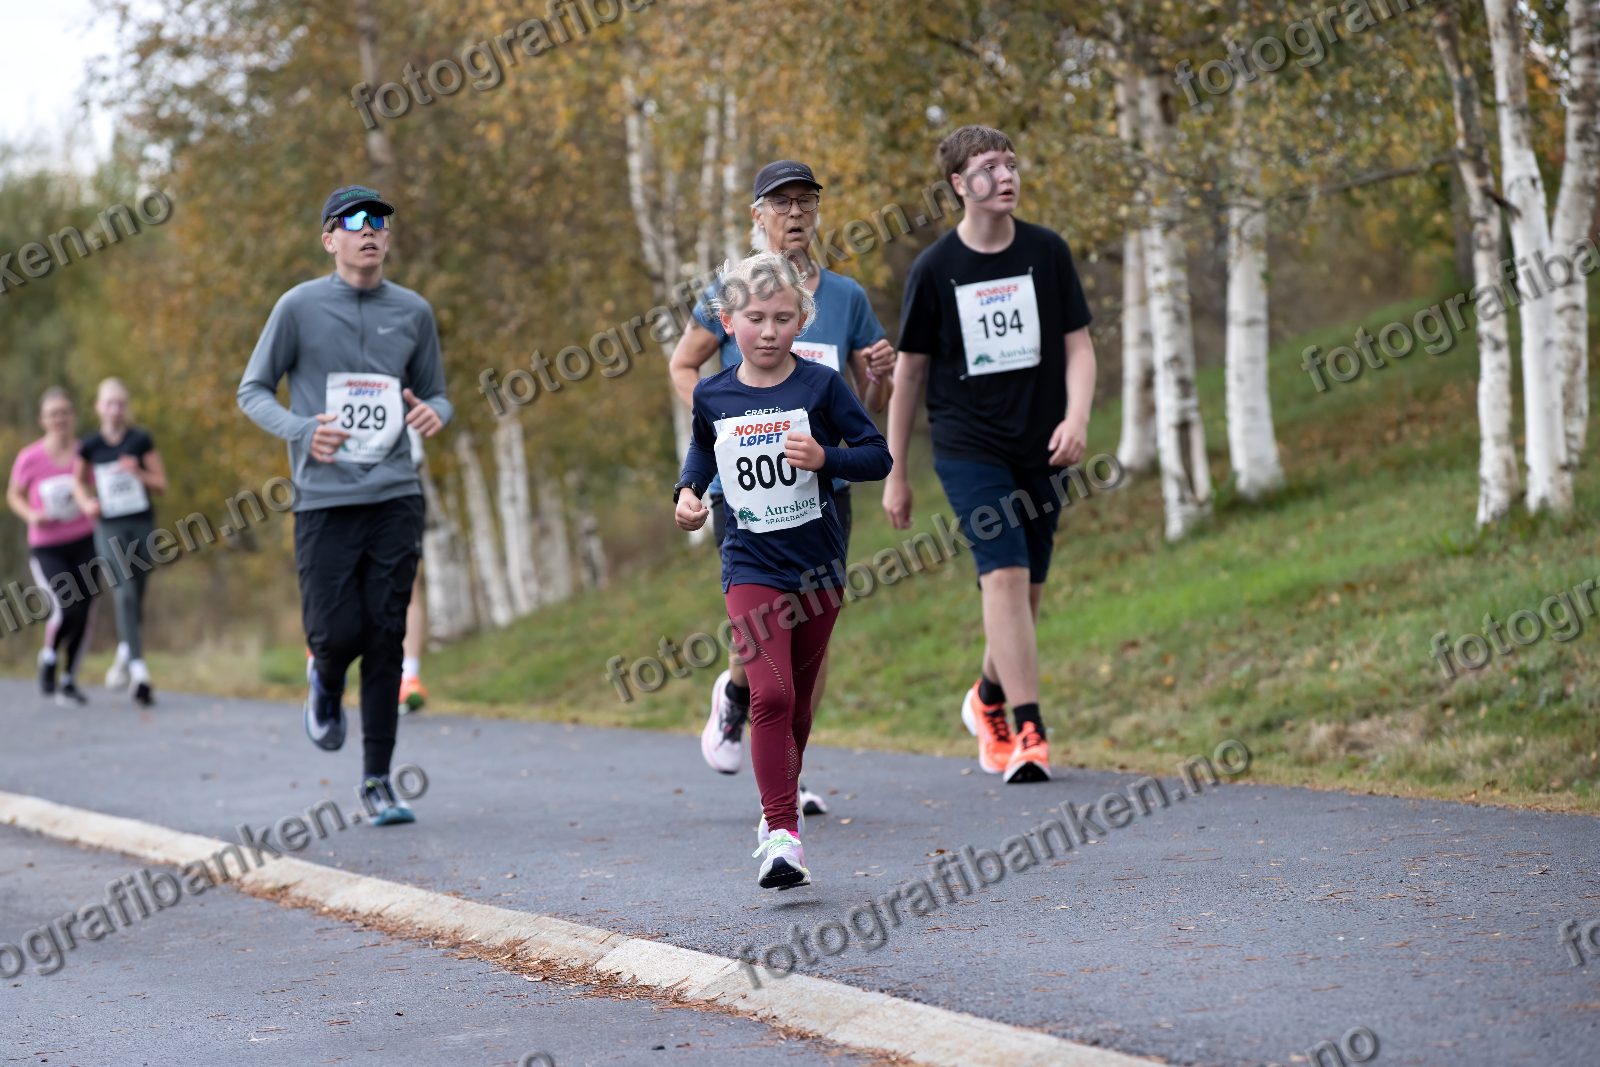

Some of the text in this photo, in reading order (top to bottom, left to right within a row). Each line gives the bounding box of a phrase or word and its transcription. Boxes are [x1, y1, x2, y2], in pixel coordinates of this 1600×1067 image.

[976, 284, 1018, 298] NORGES
[978, 308, 1024, 339] 194
[341, 404, 386, 430] 329
[744, 408, 775, 416] CRAFT
[735, 420, 791, 436] NORGES
[740, 432, 782, 447] LØPET
[736, 451, 797, 491] 800
[765, 497, 817, 517] Aurskog
[765, 510, 808, 525] SPAREBANK
